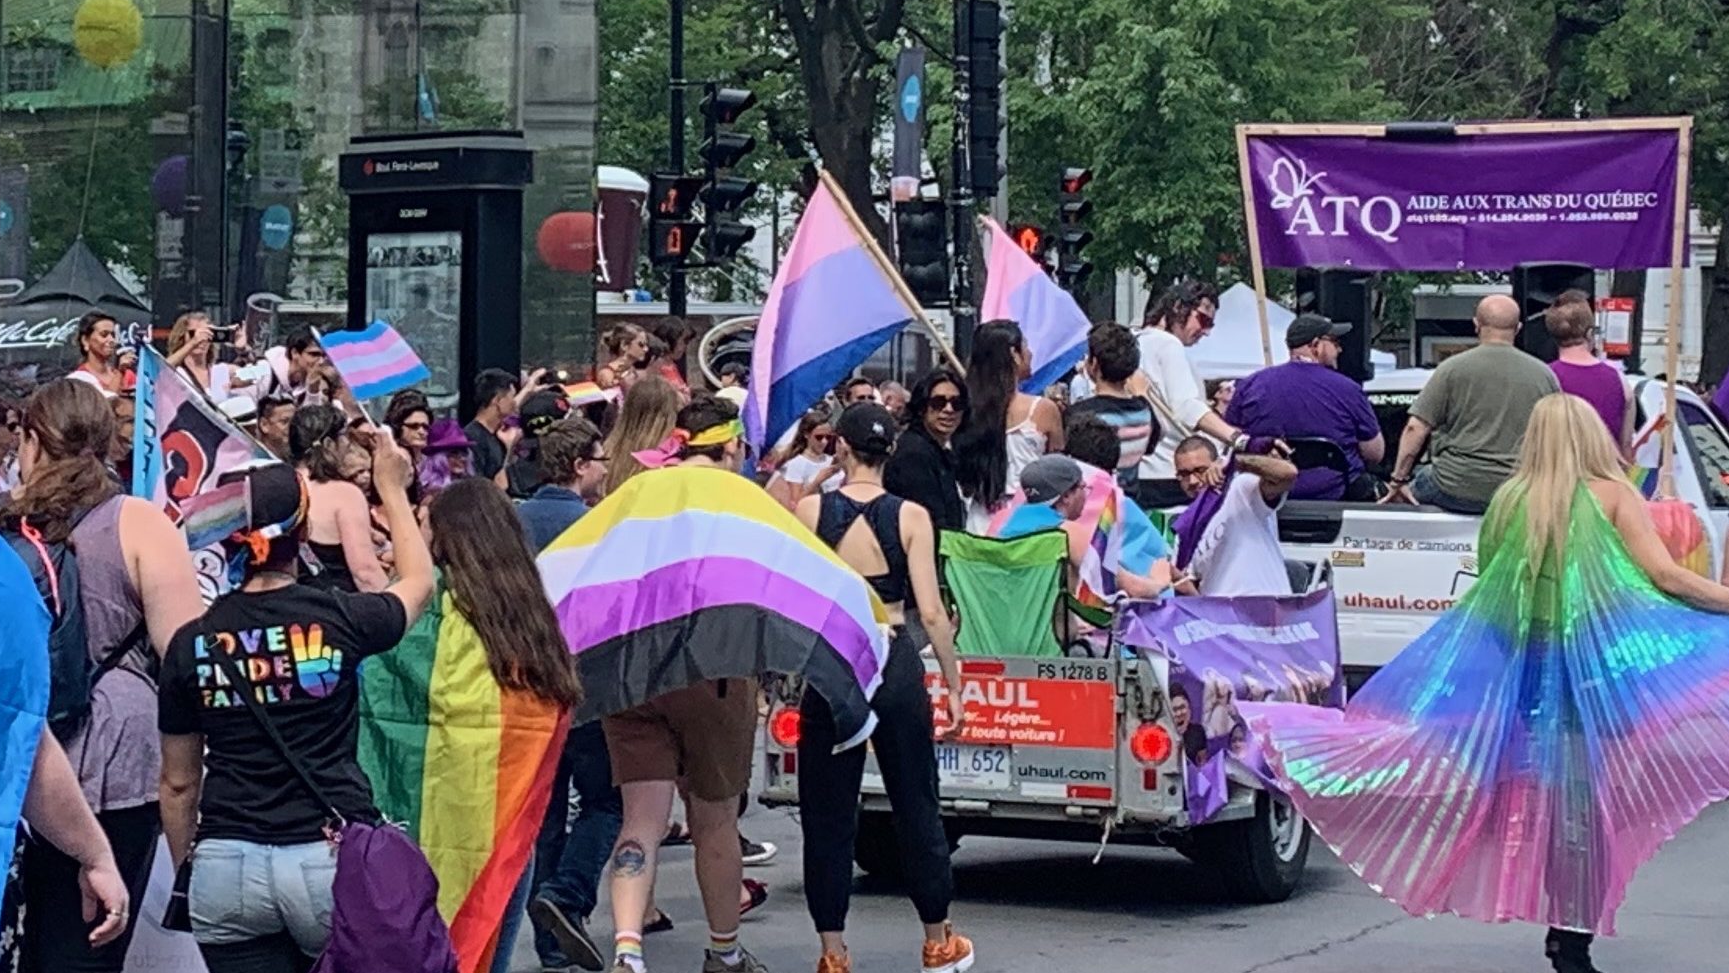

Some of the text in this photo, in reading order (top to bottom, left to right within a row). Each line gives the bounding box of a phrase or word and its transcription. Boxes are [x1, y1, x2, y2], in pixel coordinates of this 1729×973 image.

[1406, 189, 1658, 210] AIDE AUX TRANS DU QUÉBEC
[1284, 196, 1402, 242] ATQ
[1343, 536, 1472, 552] Partage de camions
[1344, 593, 1457, 611] uhaul.com
[195, 626, 287, 658] LOVE
[1037, 664, 1056, 678] FS
[1061, 665, 1093, 680] 1278
[972, 727, 1007, 739] toute
[1009, 728, 1056, 741] voiture
[972, 749, 1005, 773] 652
[1018, 764, 1107, 781] uhaul.com
